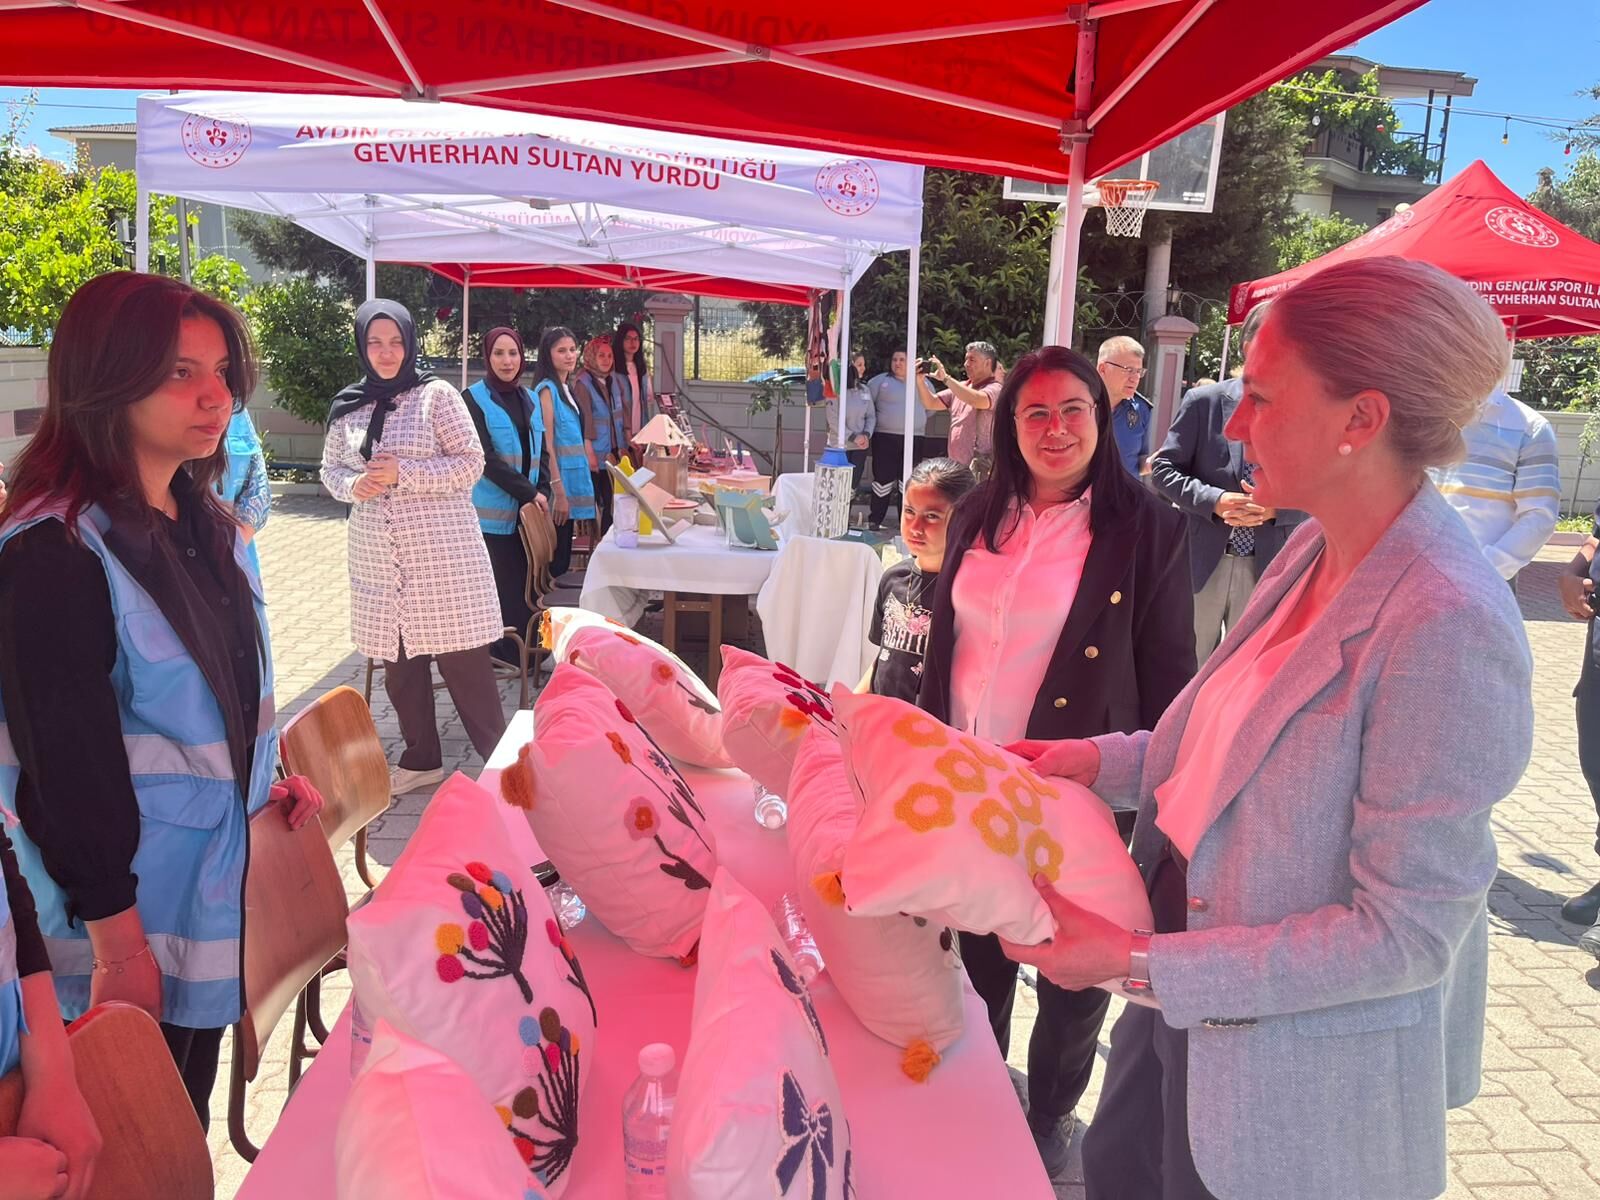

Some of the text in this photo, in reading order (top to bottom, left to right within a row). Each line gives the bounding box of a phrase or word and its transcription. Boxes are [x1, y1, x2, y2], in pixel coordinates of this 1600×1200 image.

[295, 124, 379, 140] AYDIN
[354, 143, 721, 191] GEVHERHAN SULTAN YURDU
[1465, 281, 1493, 292] DIN
[1495, 279, 1547, 293] GENÇLİK
[1549, 281, 1581, 293] SPOR
[1584, 281, 1595, 295] İL
[1480, 294, 1600, 308] GEVHERHAN SULTAN
